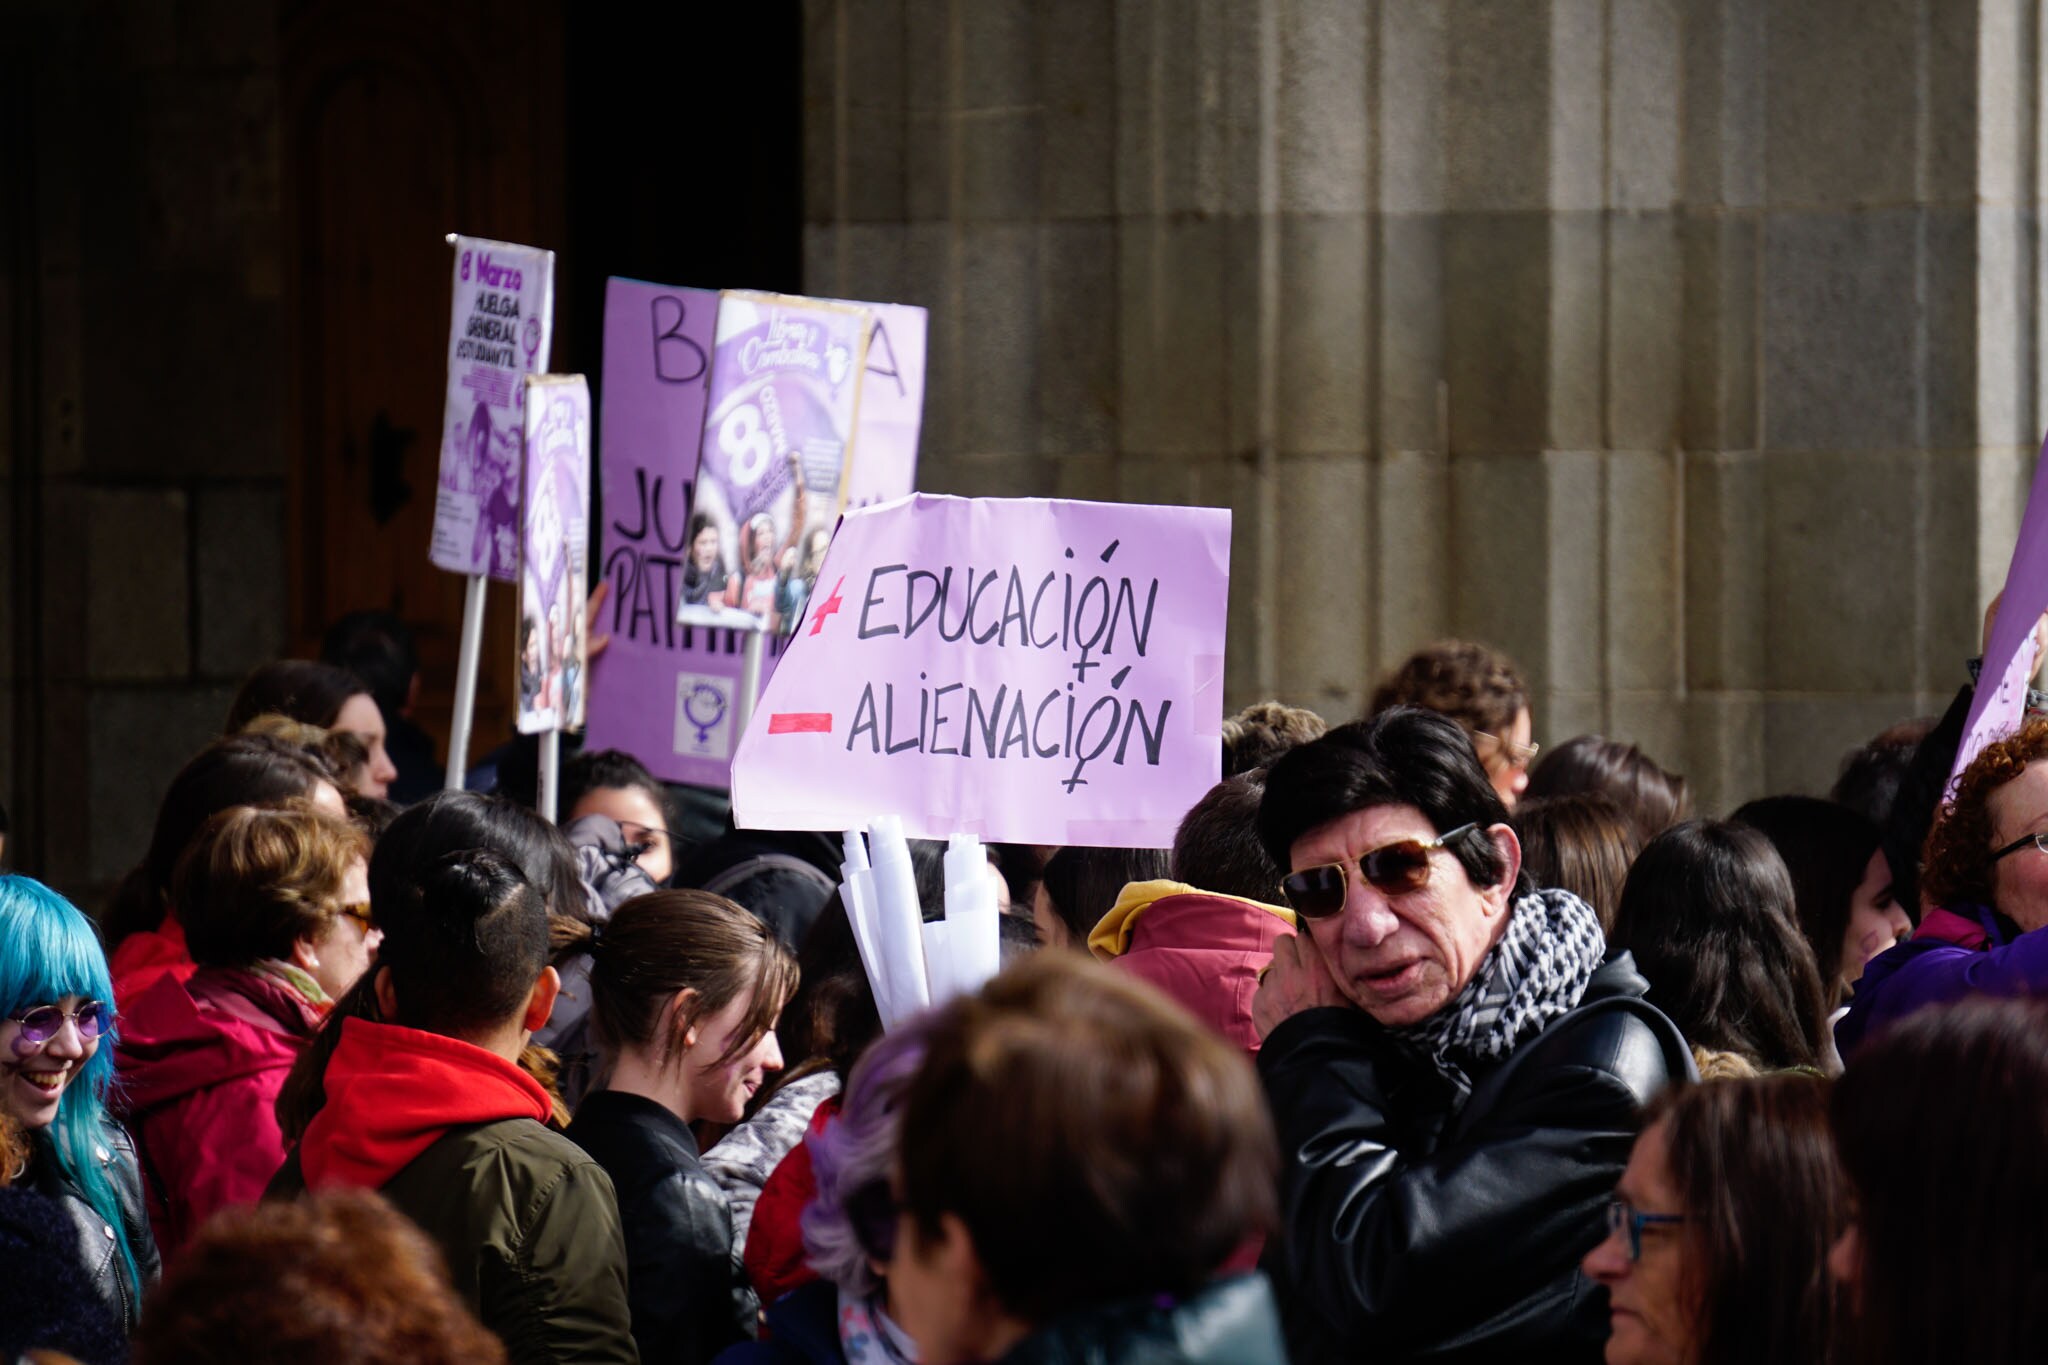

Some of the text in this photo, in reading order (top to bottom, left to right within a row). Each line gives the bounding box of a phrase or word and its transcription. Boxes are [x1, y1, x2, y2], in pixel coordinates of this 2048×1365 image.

[460, 250, 523, 291] 8 Marzo
[466, 312, 517, 346] GENERAL
[718, 403, 771, 487] 8
